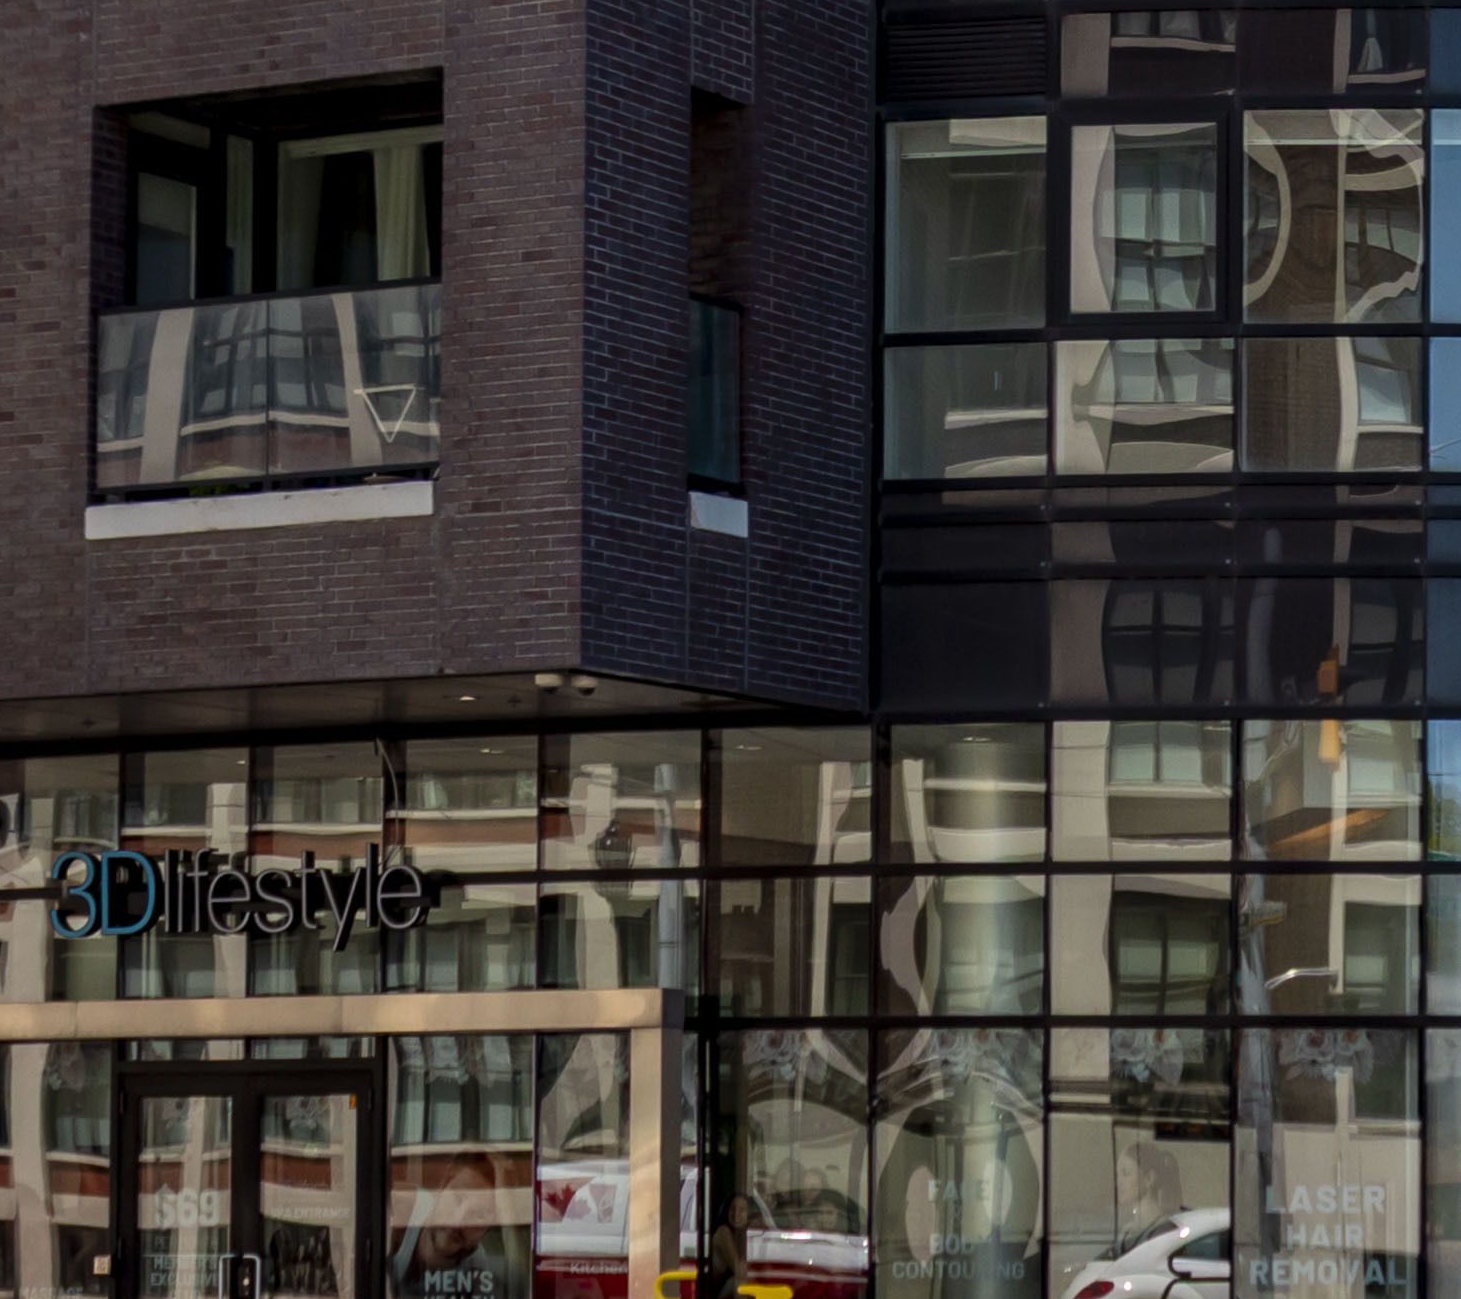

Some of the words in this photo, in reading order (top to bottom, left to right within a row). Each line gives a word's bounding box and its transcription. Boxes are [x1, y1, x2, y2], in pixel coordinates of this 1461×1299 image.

[1265, 1184, 1386, 1215] LASER
[1286, 1223, 1365, 1250] HAIR
[423, 1270, 494, 1292] MEN'S
[891, 1260, 1026, 1280] CONTOUNG
[1249, 1257, 1408, 1287] REMOVAL
